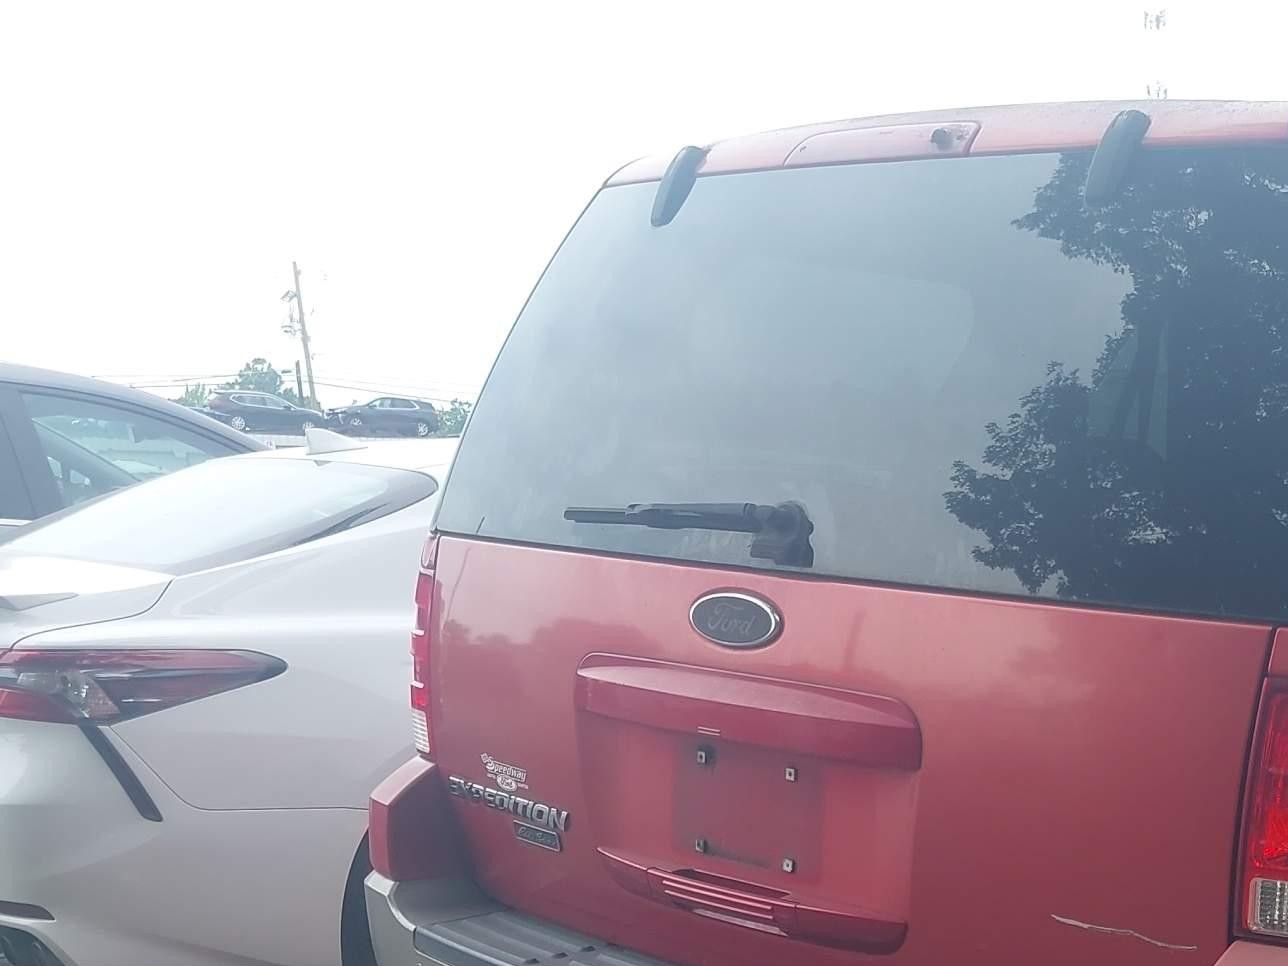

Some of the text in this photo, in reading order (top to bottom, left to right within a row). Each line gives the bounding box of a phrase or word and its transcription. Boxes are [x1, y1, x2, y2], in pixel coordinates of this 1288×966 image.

[707, 602, 758, 636] Ford
[485, 756, 527, 783] Speedway
[448, 776, 569, 832] EXPEDITION
